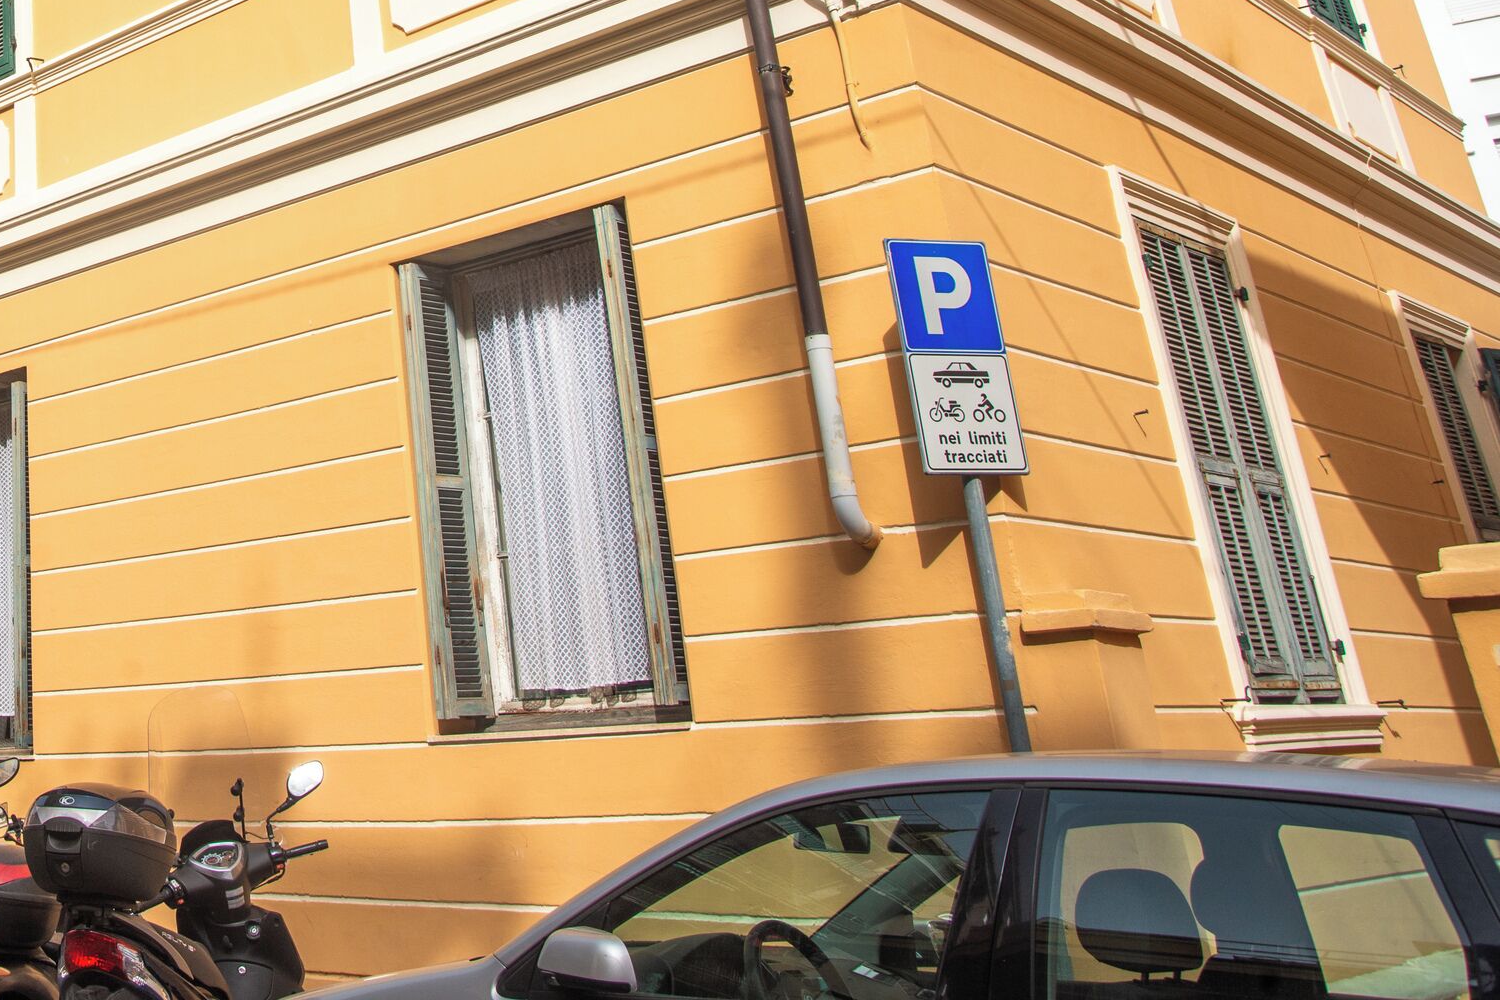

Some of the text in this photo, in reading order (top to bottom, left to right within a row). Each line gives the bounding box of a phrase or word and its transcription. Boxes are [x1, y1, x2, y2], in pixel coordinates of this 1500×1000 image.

[912, 256, 972, 335] P
[939, 431, 1007, 445] nei limiti
[944, 449, 1008, 464] tracciati
